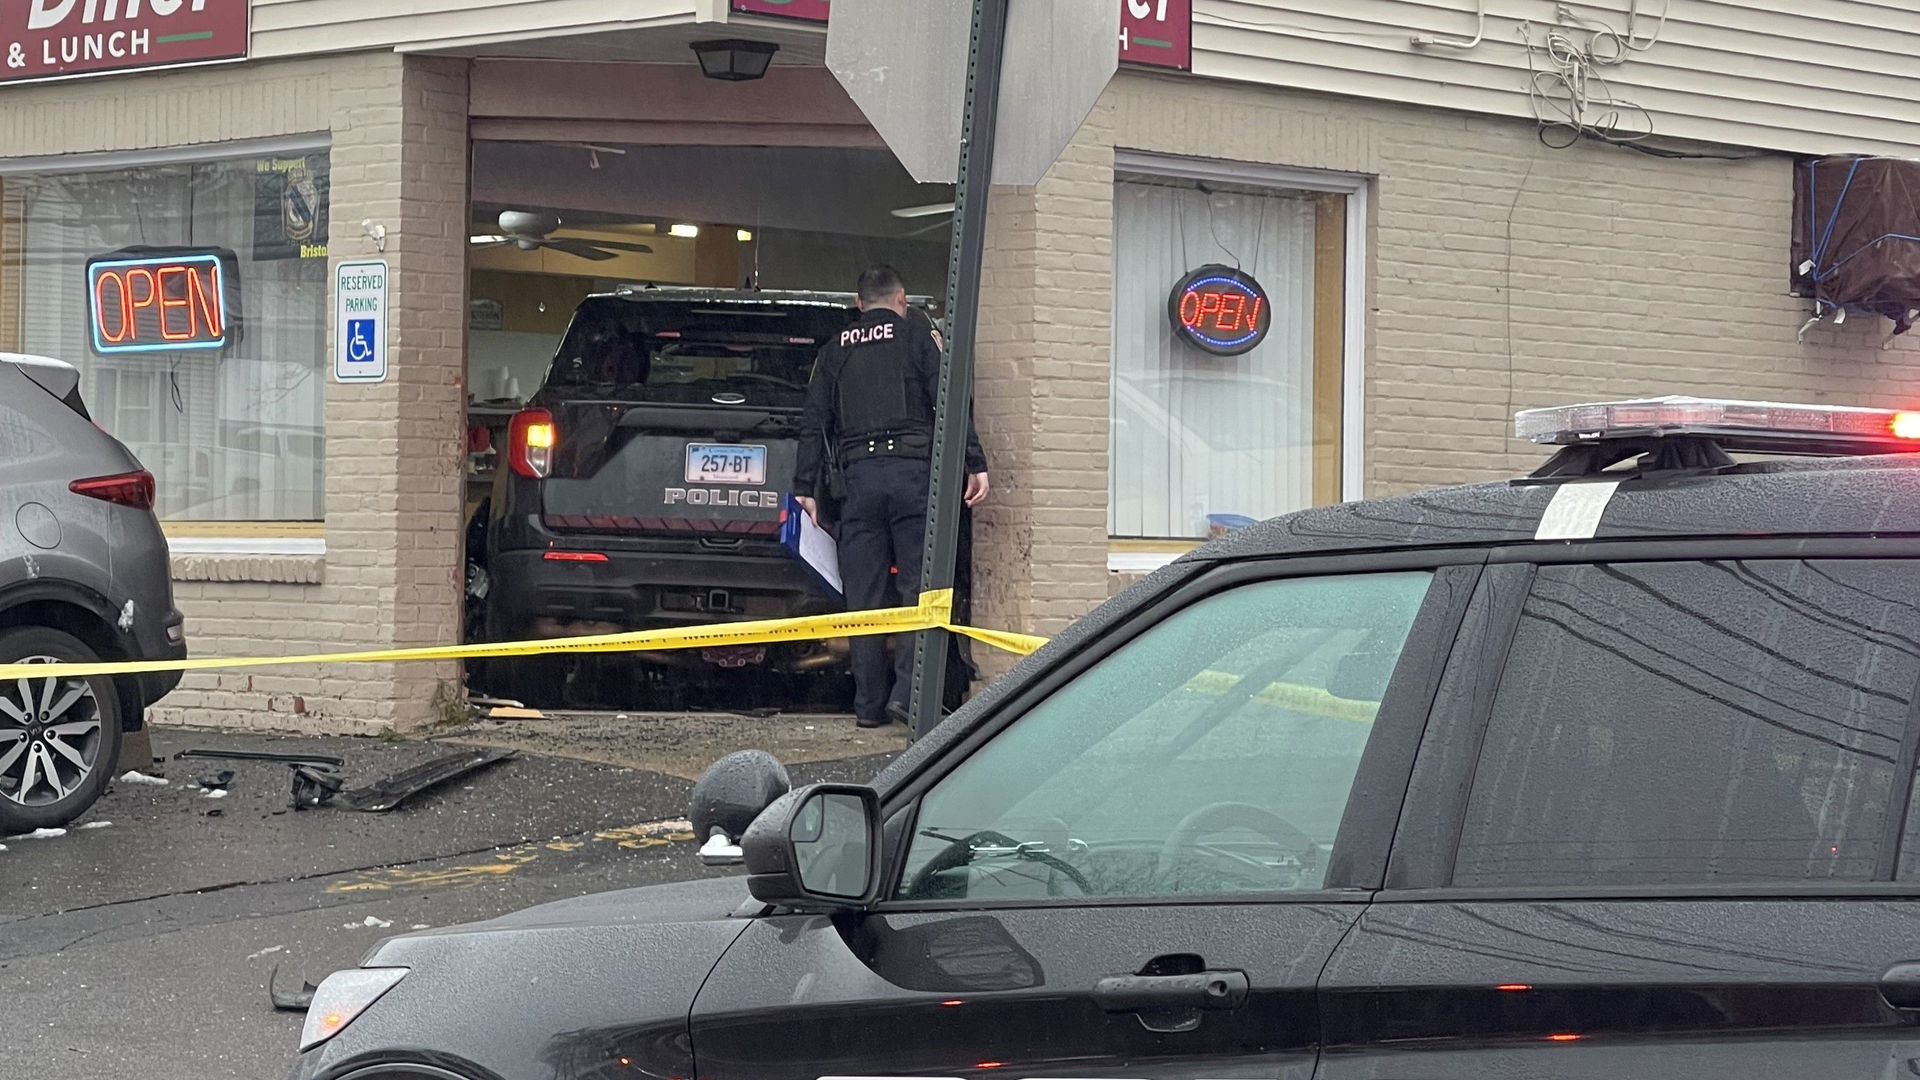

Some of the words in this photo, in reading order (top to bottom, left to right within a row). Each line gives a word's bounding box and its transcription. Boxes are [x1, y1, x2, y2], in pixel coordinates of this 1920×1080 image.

[7, 42, 26, 68] &
[43, 28, 149, 64] LUNCH
[272, 156, 306, 173] Support
[341, 275, 383, 290] RESERVED
[96, 265, 221, 342] OPEN
[345, 297, 378, 312] PARKING
[1180, 290, 1262, 331] OPEN
[840, 323, 894, 347] POLICE
[663, 487, 779, 509] POLICE
